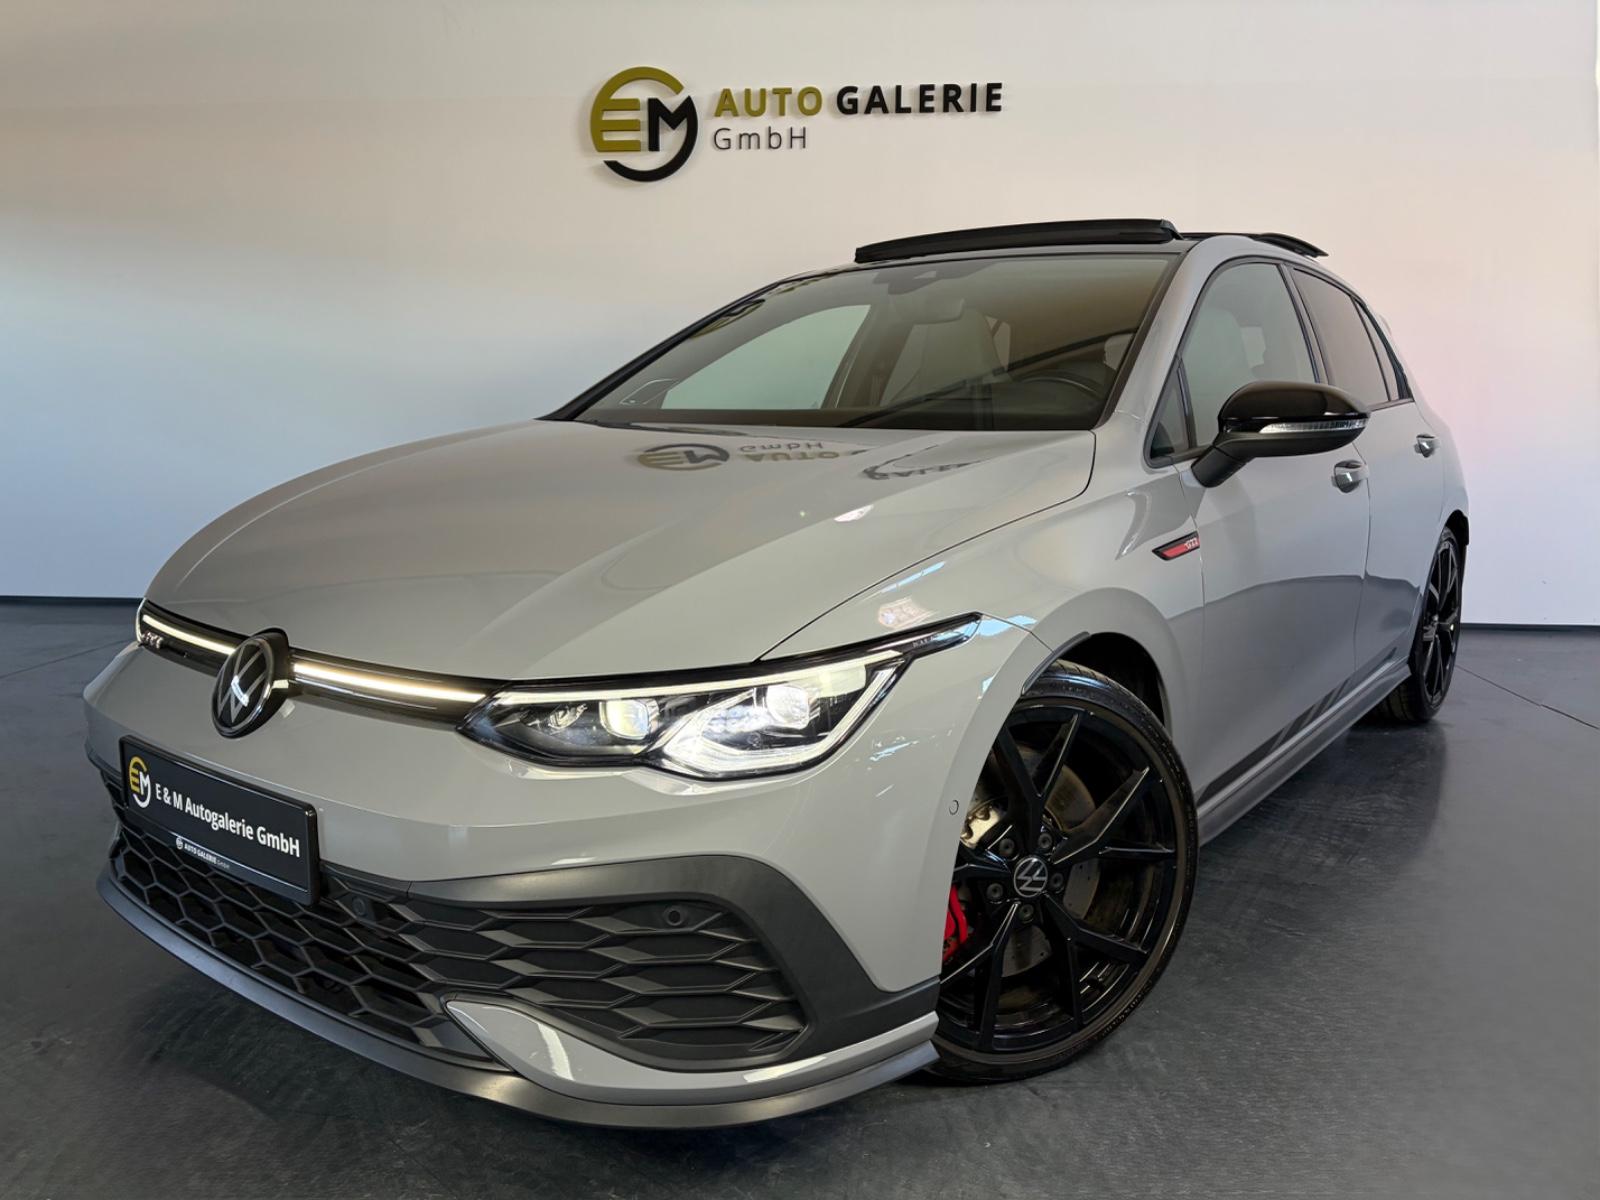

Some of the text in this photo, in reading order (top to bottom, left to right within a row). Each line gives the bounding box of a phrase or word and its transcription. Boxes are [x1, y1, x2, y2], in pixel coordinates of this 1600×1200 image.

[714, 82, 1003, 118] AUTO GALERIE
[713, 126, 807, 150] GmbH
[155, 783, 300, 858] E & M Autogalerie GmbH
